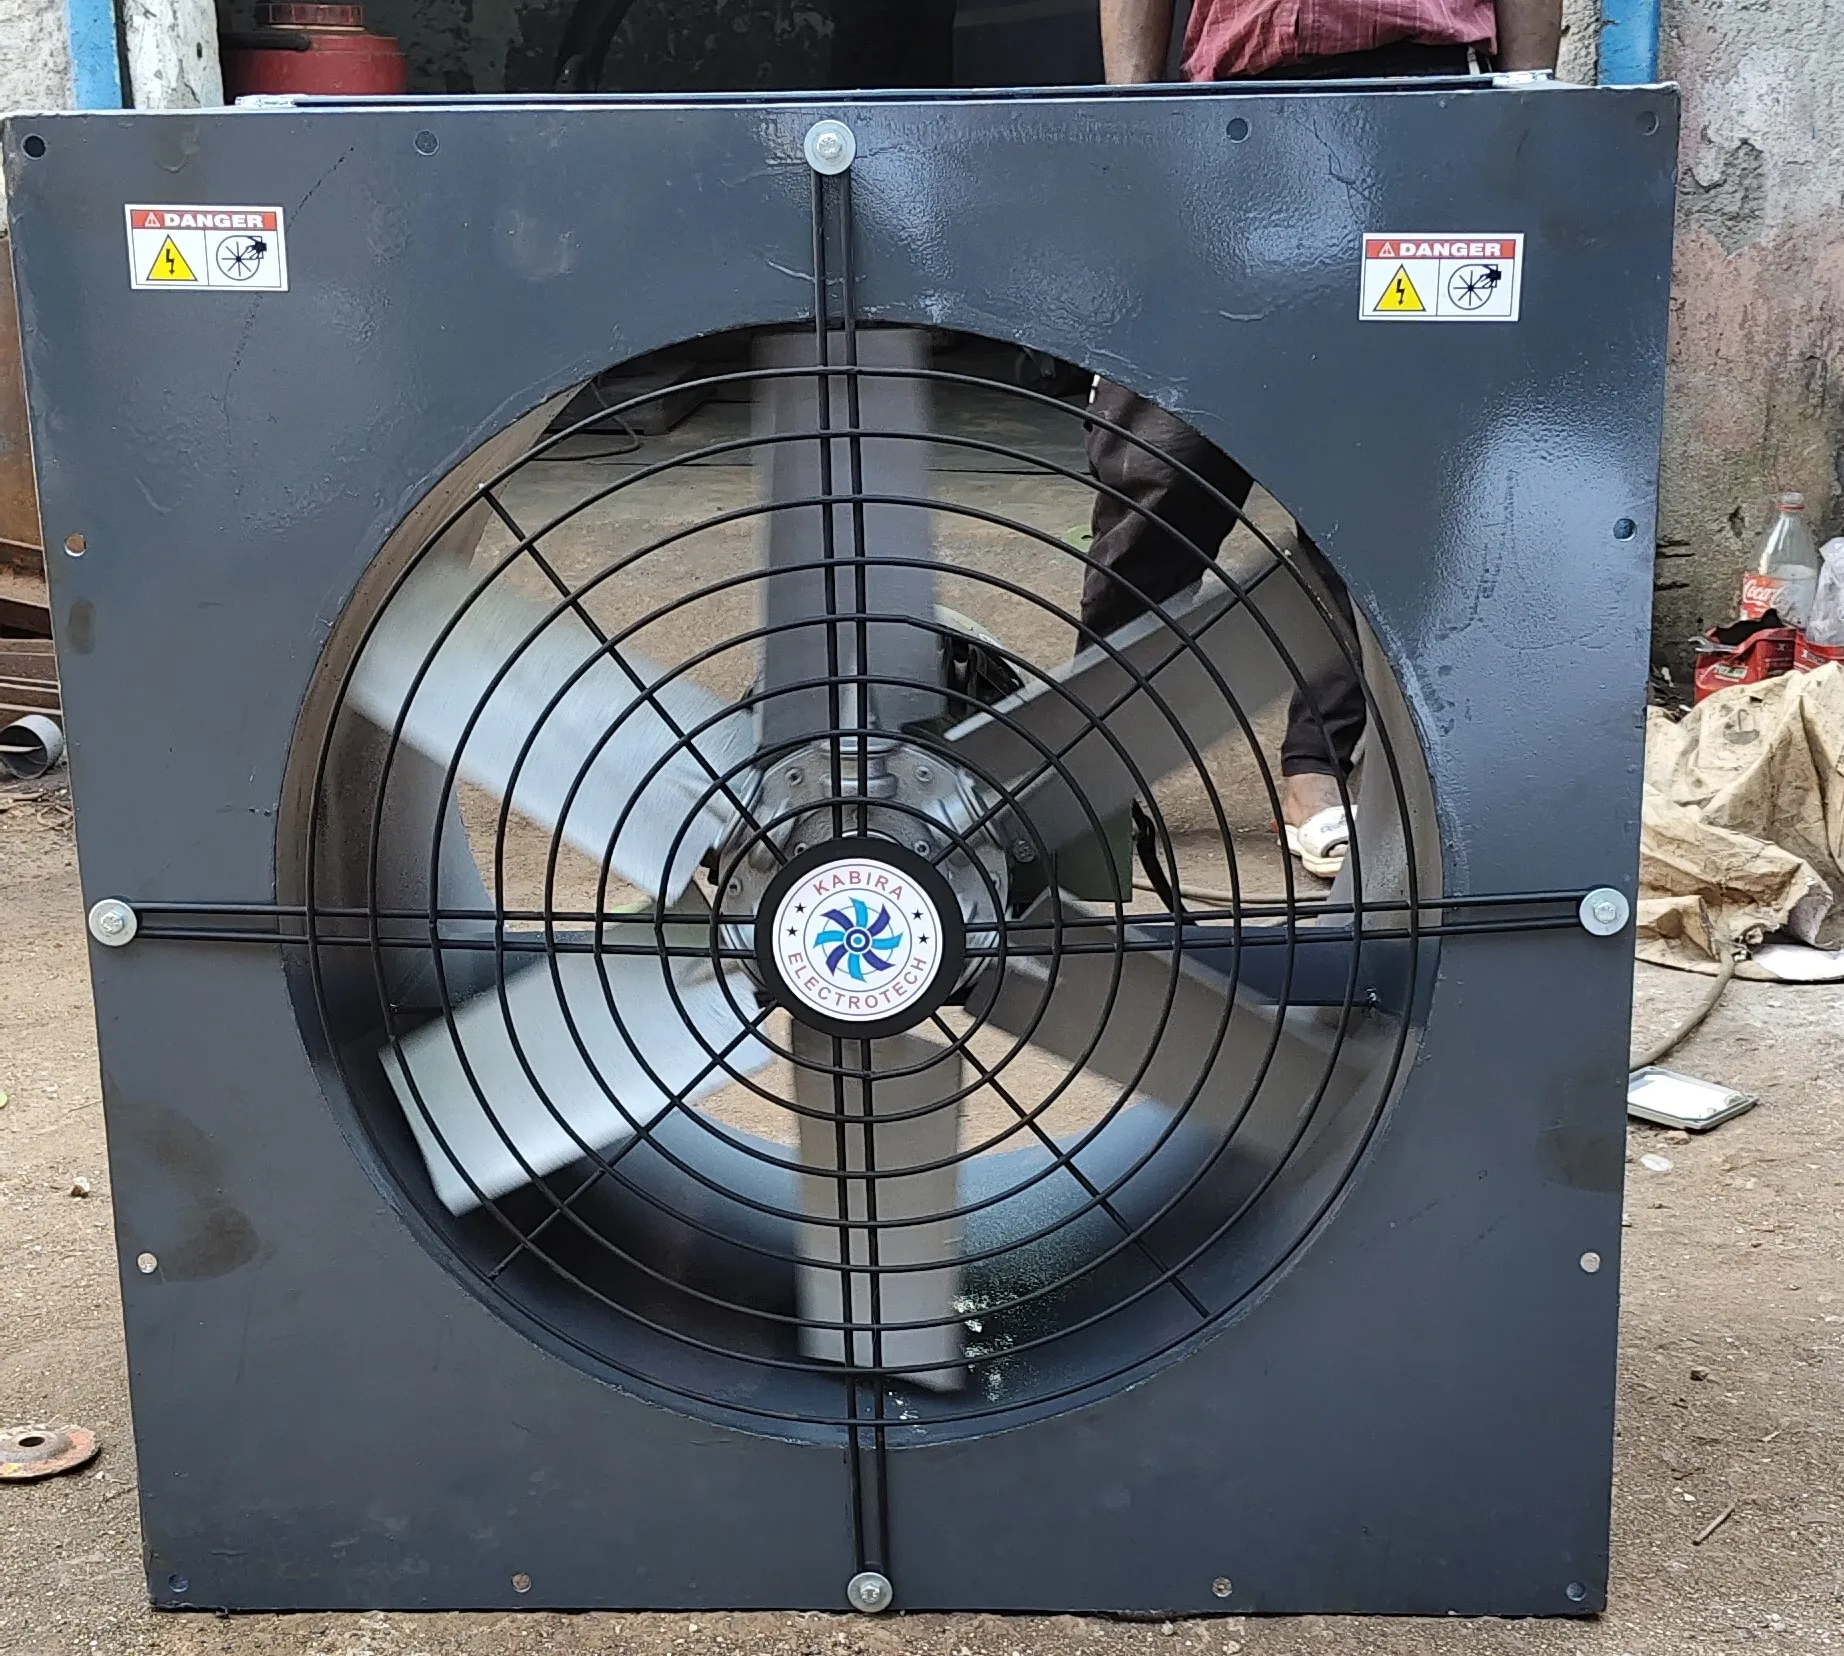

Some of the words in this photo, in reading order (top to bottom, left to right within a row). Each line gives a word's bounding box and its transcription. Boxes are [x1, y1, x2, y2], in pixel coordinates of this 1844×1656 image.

[164, 212, 264, 228] DANGER
[1400, 242, 1501, 257] DANGER
[813, 870, 903, 900] KABIRA
[788, 952, 927, 1009] ELECTROTECH
